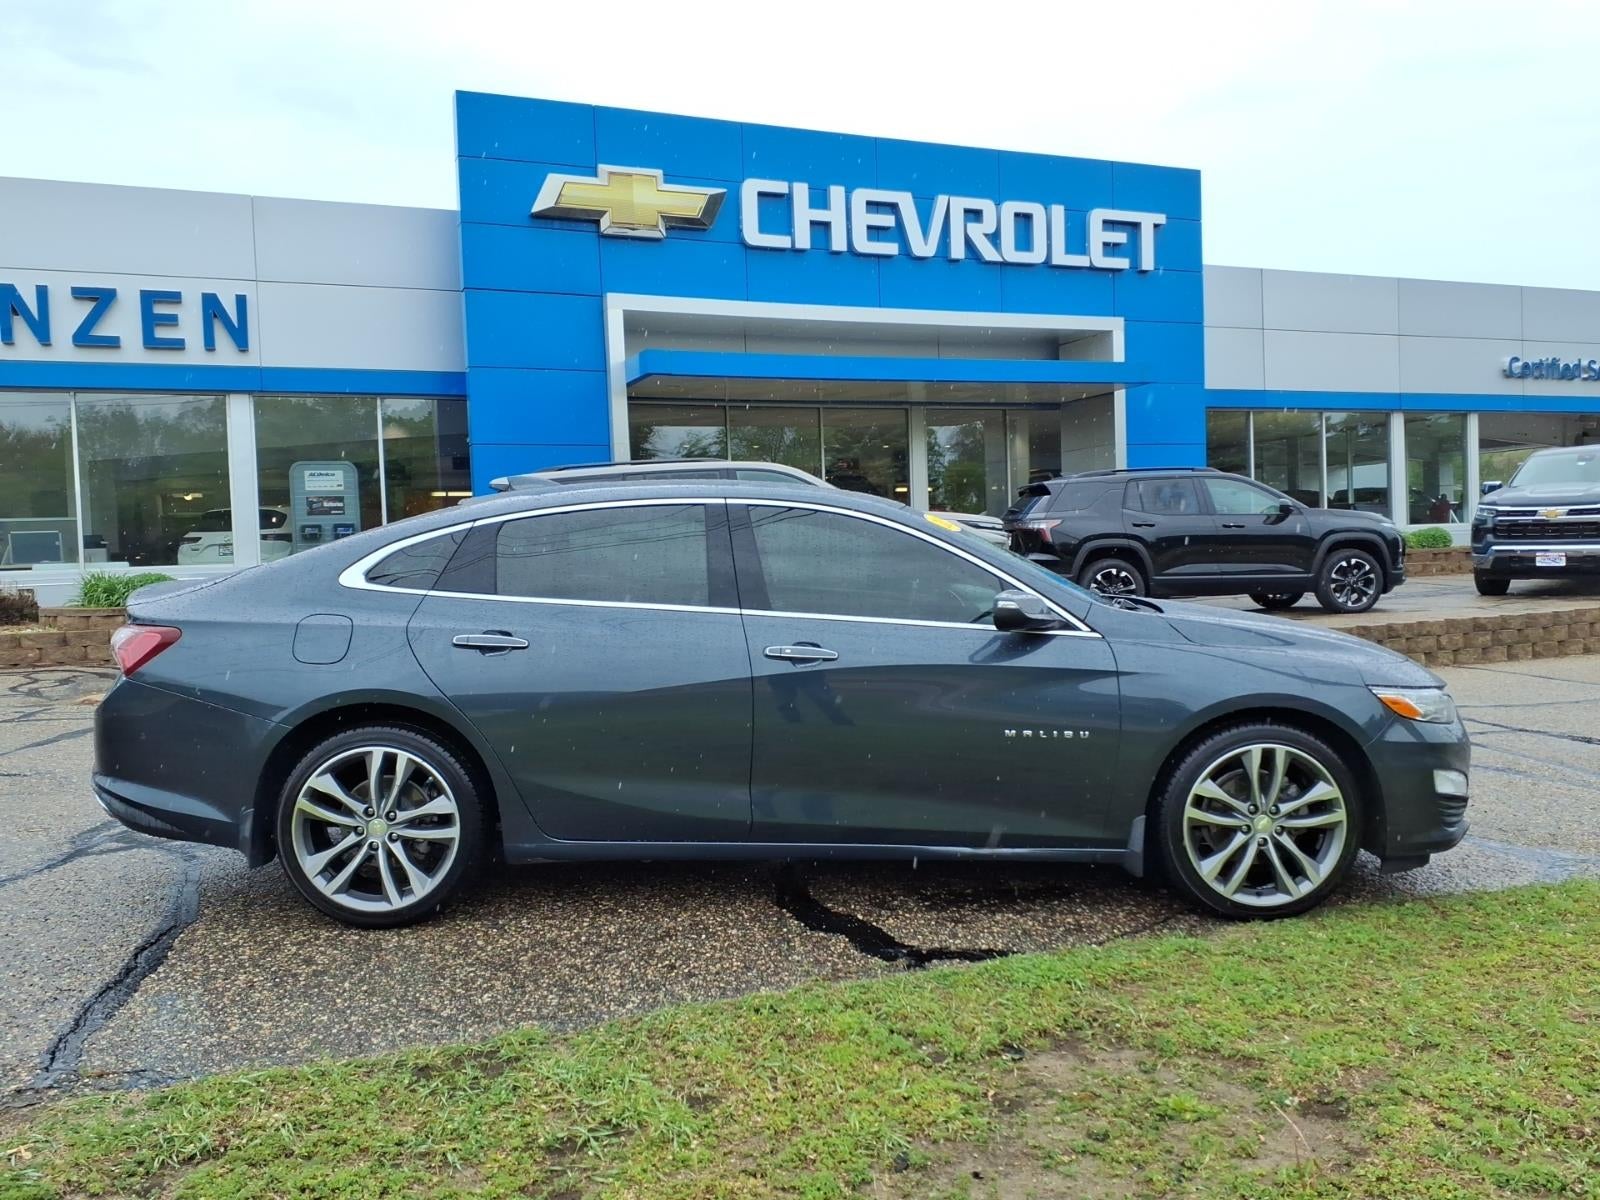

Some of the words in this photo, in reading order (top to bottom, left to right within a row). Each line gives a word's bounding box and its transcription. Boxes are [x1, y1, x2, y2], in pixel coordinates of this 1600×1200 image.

[741, 177, 1167, 272] CHEVROLET
[1504, 356, 1581, 380] Certified
[1585, 359, 1600, 381] S
[1004, 729, 1089, 739] MALIBU
